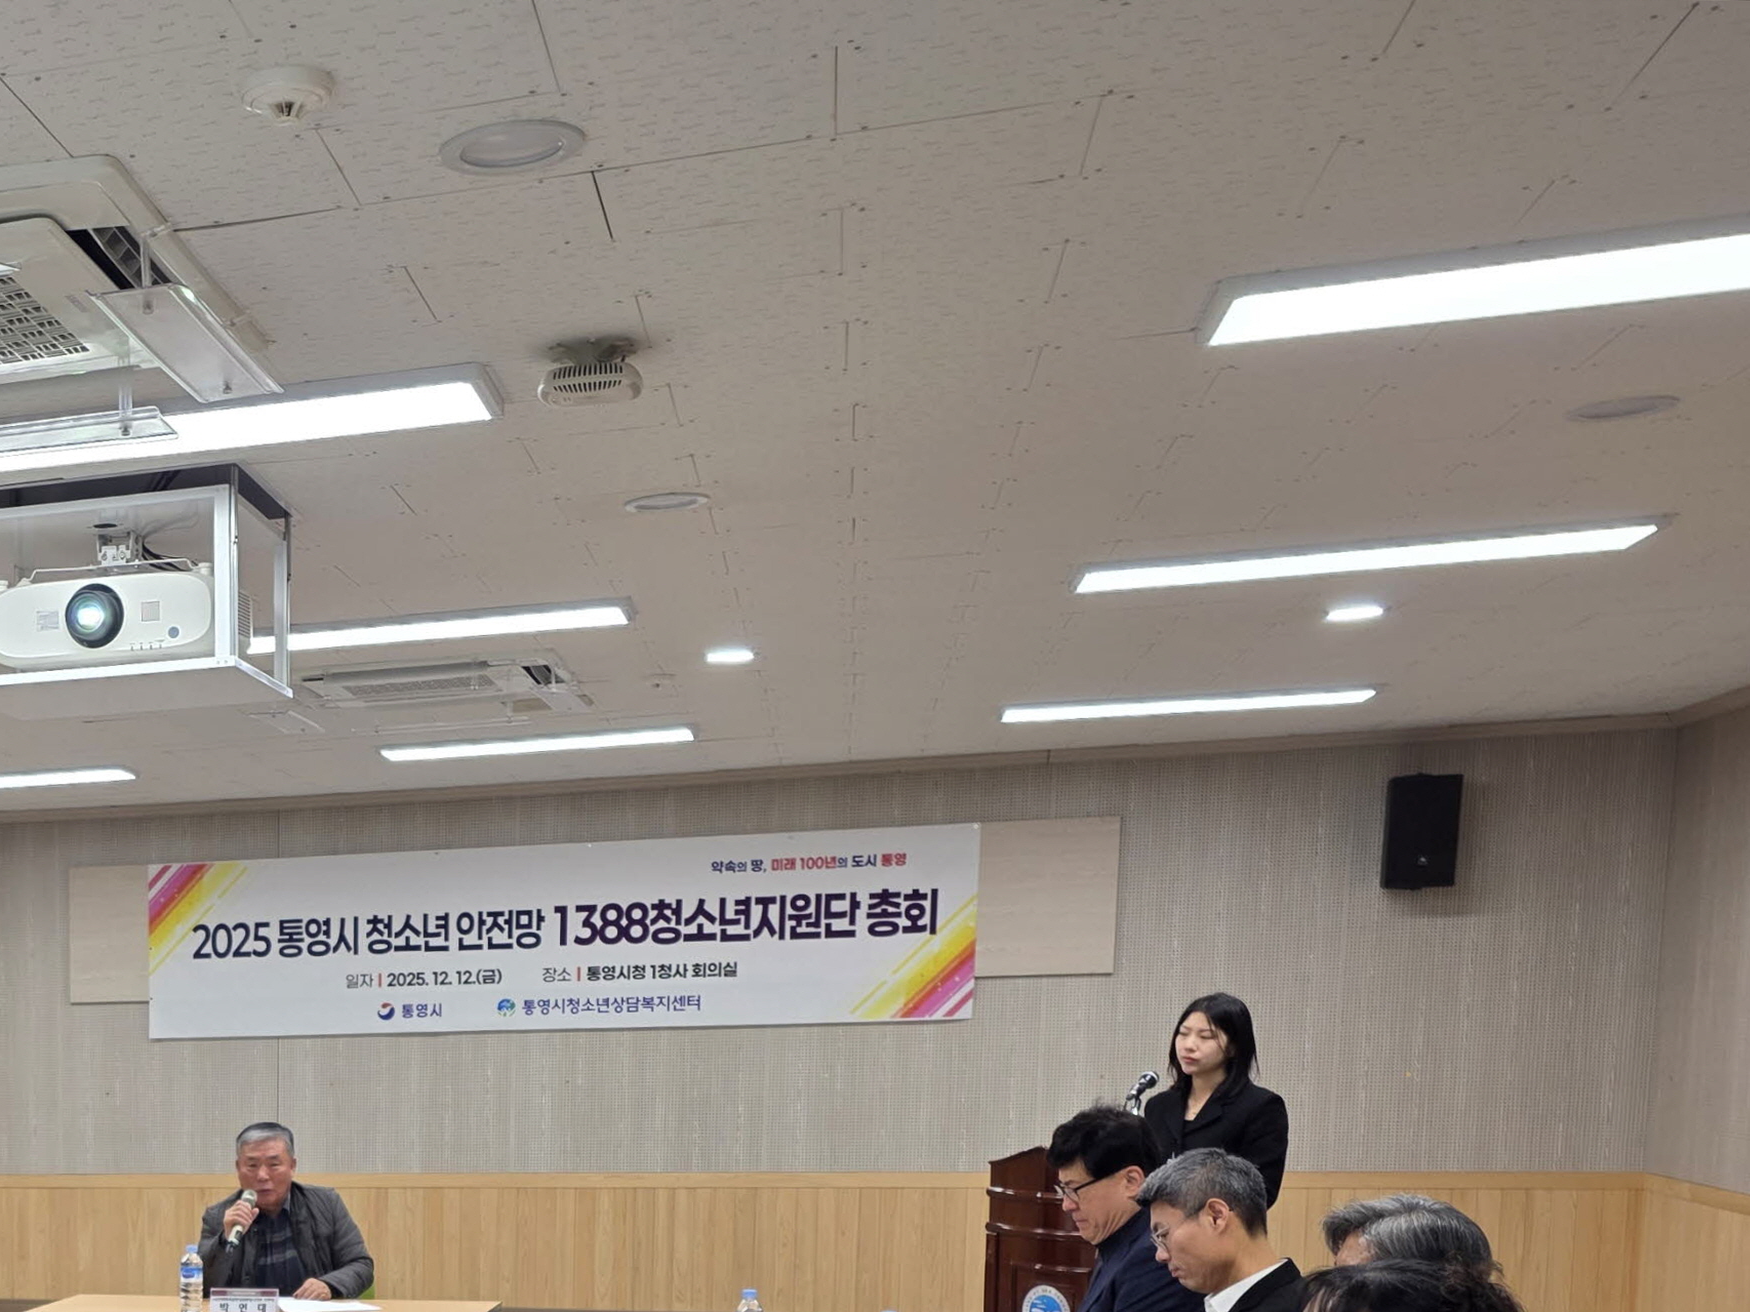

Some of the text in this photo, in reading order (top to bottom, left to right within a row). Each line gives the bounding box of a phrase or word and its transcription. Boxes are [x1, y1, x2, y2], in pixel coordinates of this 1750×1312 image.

[710, 859, 748, 874] 약속의
[771, 857, 797, 872] 미래
[799, 855, 848, 871] 100년의
[851, 853, 878, 869] 도시
[880, 852, 907, 868] 통영
[191, 888, 939, 960] 2025 통영시 청소년 안전망 1388청소년지원단 총회
[345, 972, 374, 989] 일자
[541, 961, 738, 982] 장소 통영시청 1청사 회의실
[401, 1002, 443, 1019] 통영시
[521, 994, 702, 1016] 통영시청소년상담복지센터
